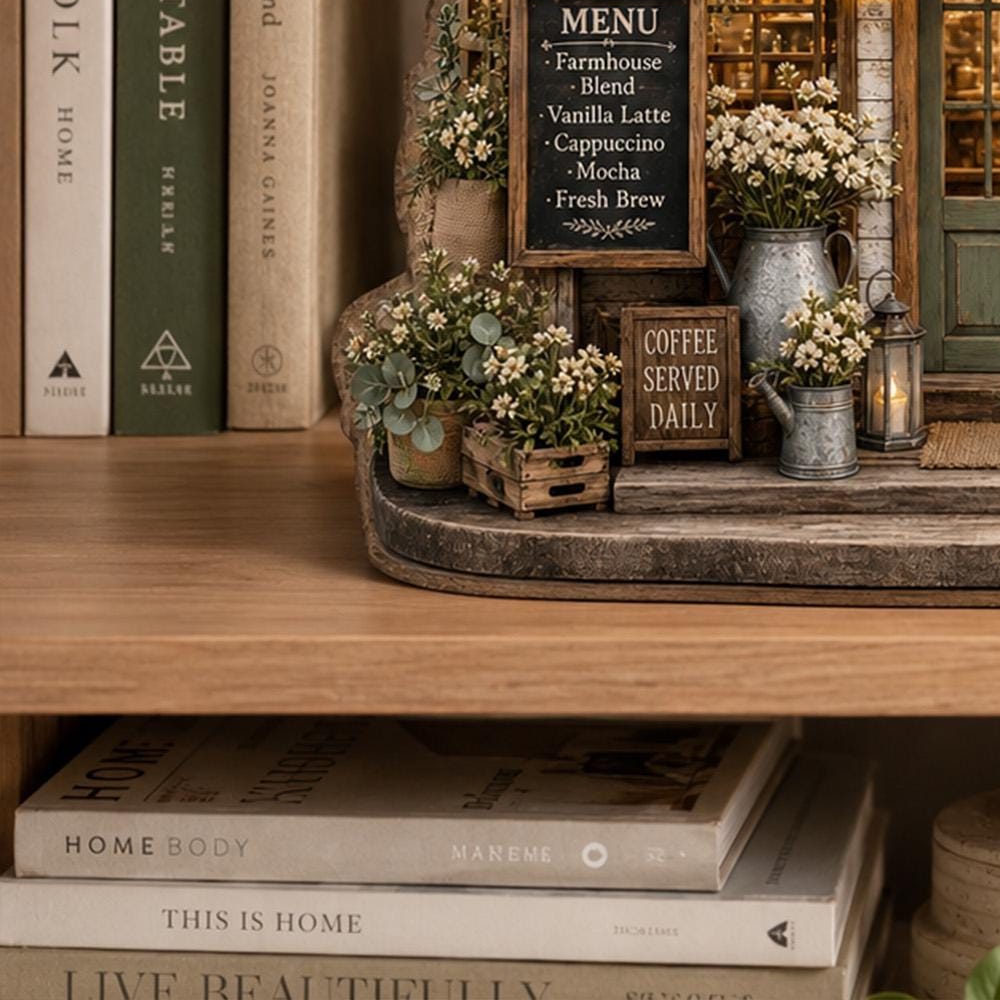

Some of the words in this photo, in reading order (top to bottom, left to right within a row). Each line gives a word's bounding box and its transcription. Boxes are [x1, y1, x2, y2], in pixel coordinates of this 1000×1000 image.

[560, 7, 660, 36] MENU
[556, 52, 663, 71] Farmhouse
[580, 77, 636, 96] Blend
[547, 105, 614, 125] Vanilla
[621, 105, 672, 125] Latte
[57, 106, 74, 185] HOME
[554, 133, 666, 158] Cappuccino
[576, 161, 642, 181] Mocha
[555, 189, 609, 209] Fresh
[617, 191, 666, 209] Brew
[261, 175, 277, 260] GAINES
[644, 328, 719, 356] COFFEE
[643, 364, 720, 393] SERVED
[649, 402, 718, 430] DAILY
[65, 835, 155, 856] HOME
[167, 836, 249, 857] BODY
[161, 908, 230, 931] THIS
[240, 911, 264, 932] IS
[275, 912, 363, 934] HOME
[64, 970, 177, 1000] LIVE
